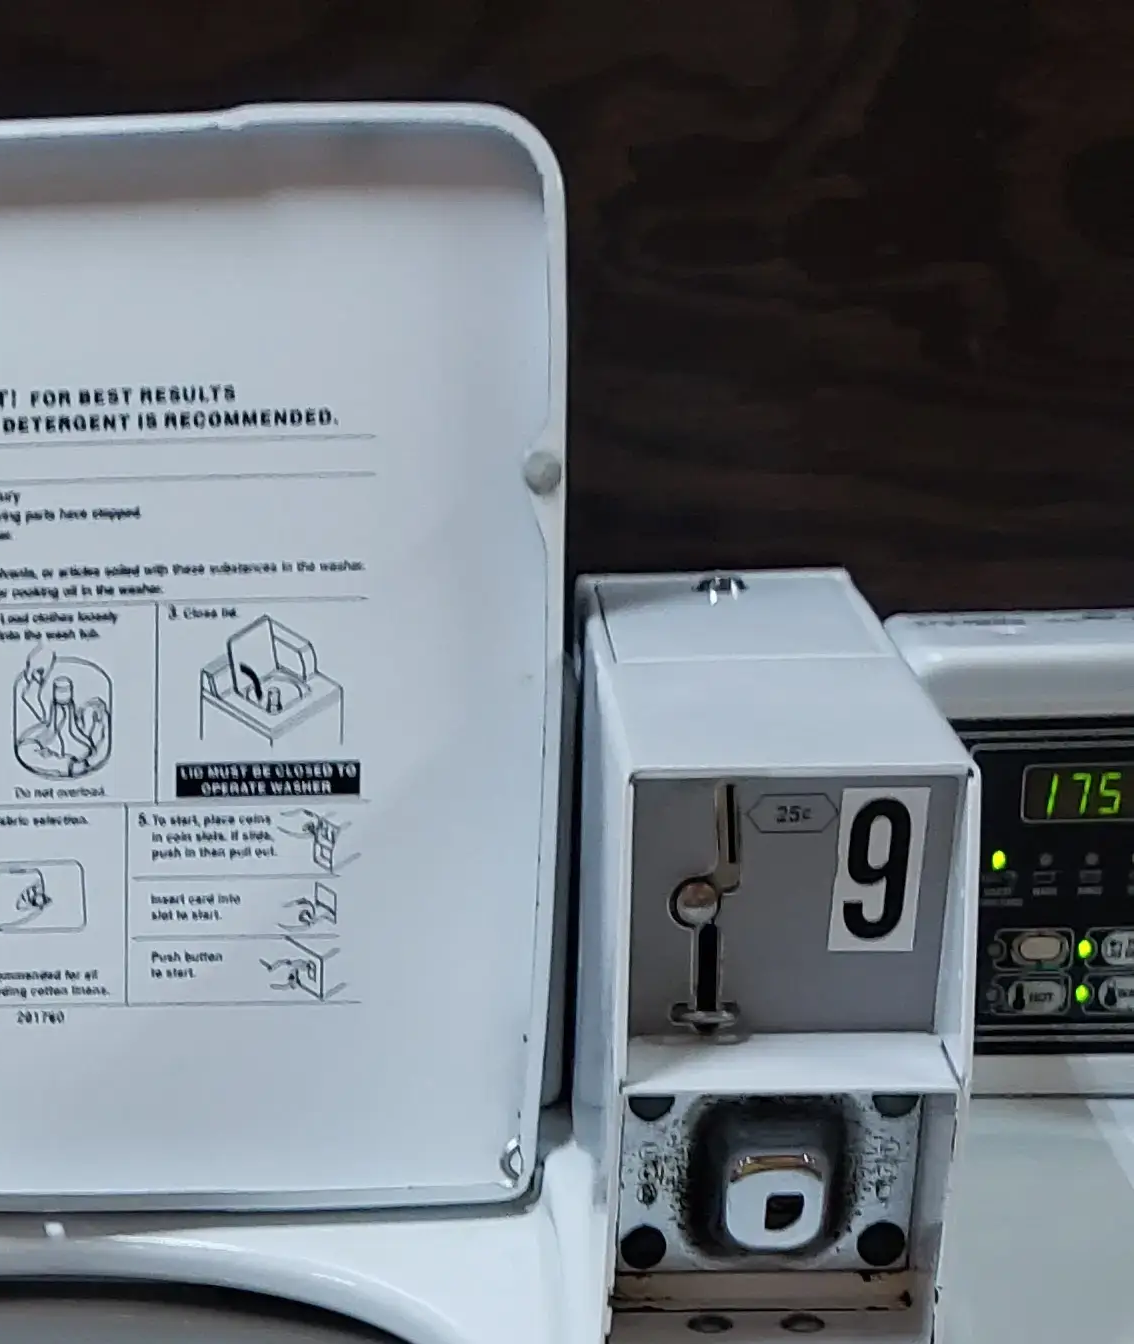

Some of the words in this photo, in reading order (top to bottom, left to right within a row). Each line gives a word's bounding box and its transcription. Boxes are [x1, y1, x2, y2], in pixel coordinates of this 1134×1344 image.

[29, 391, 72, 407] FOR
[77, 388, 134, 405] BEST
[139, 386, 236, 404] RESULTS
[1, 415, 132, 433] DETERGENT
[137, 412, 158, 430] IS
[161, 410, 340, 428] RECOMMENDED.
[180, 766, 204, 780] LID
[207, 765, 248, 779] MUST
[252, 764, 271, 779] BE
[275, 763, 333, 778] CLOSED
[336, 763, 357, 778] TO
[201, 781, 266, 796] OPERATE
[270, 780, 332, 795] WASHER
[1046, 772, 1122, 817] 175
[843, 797, 911, 940] 9
[150, 951, 182, 963] Push
[184, 952, 223, 962] button
